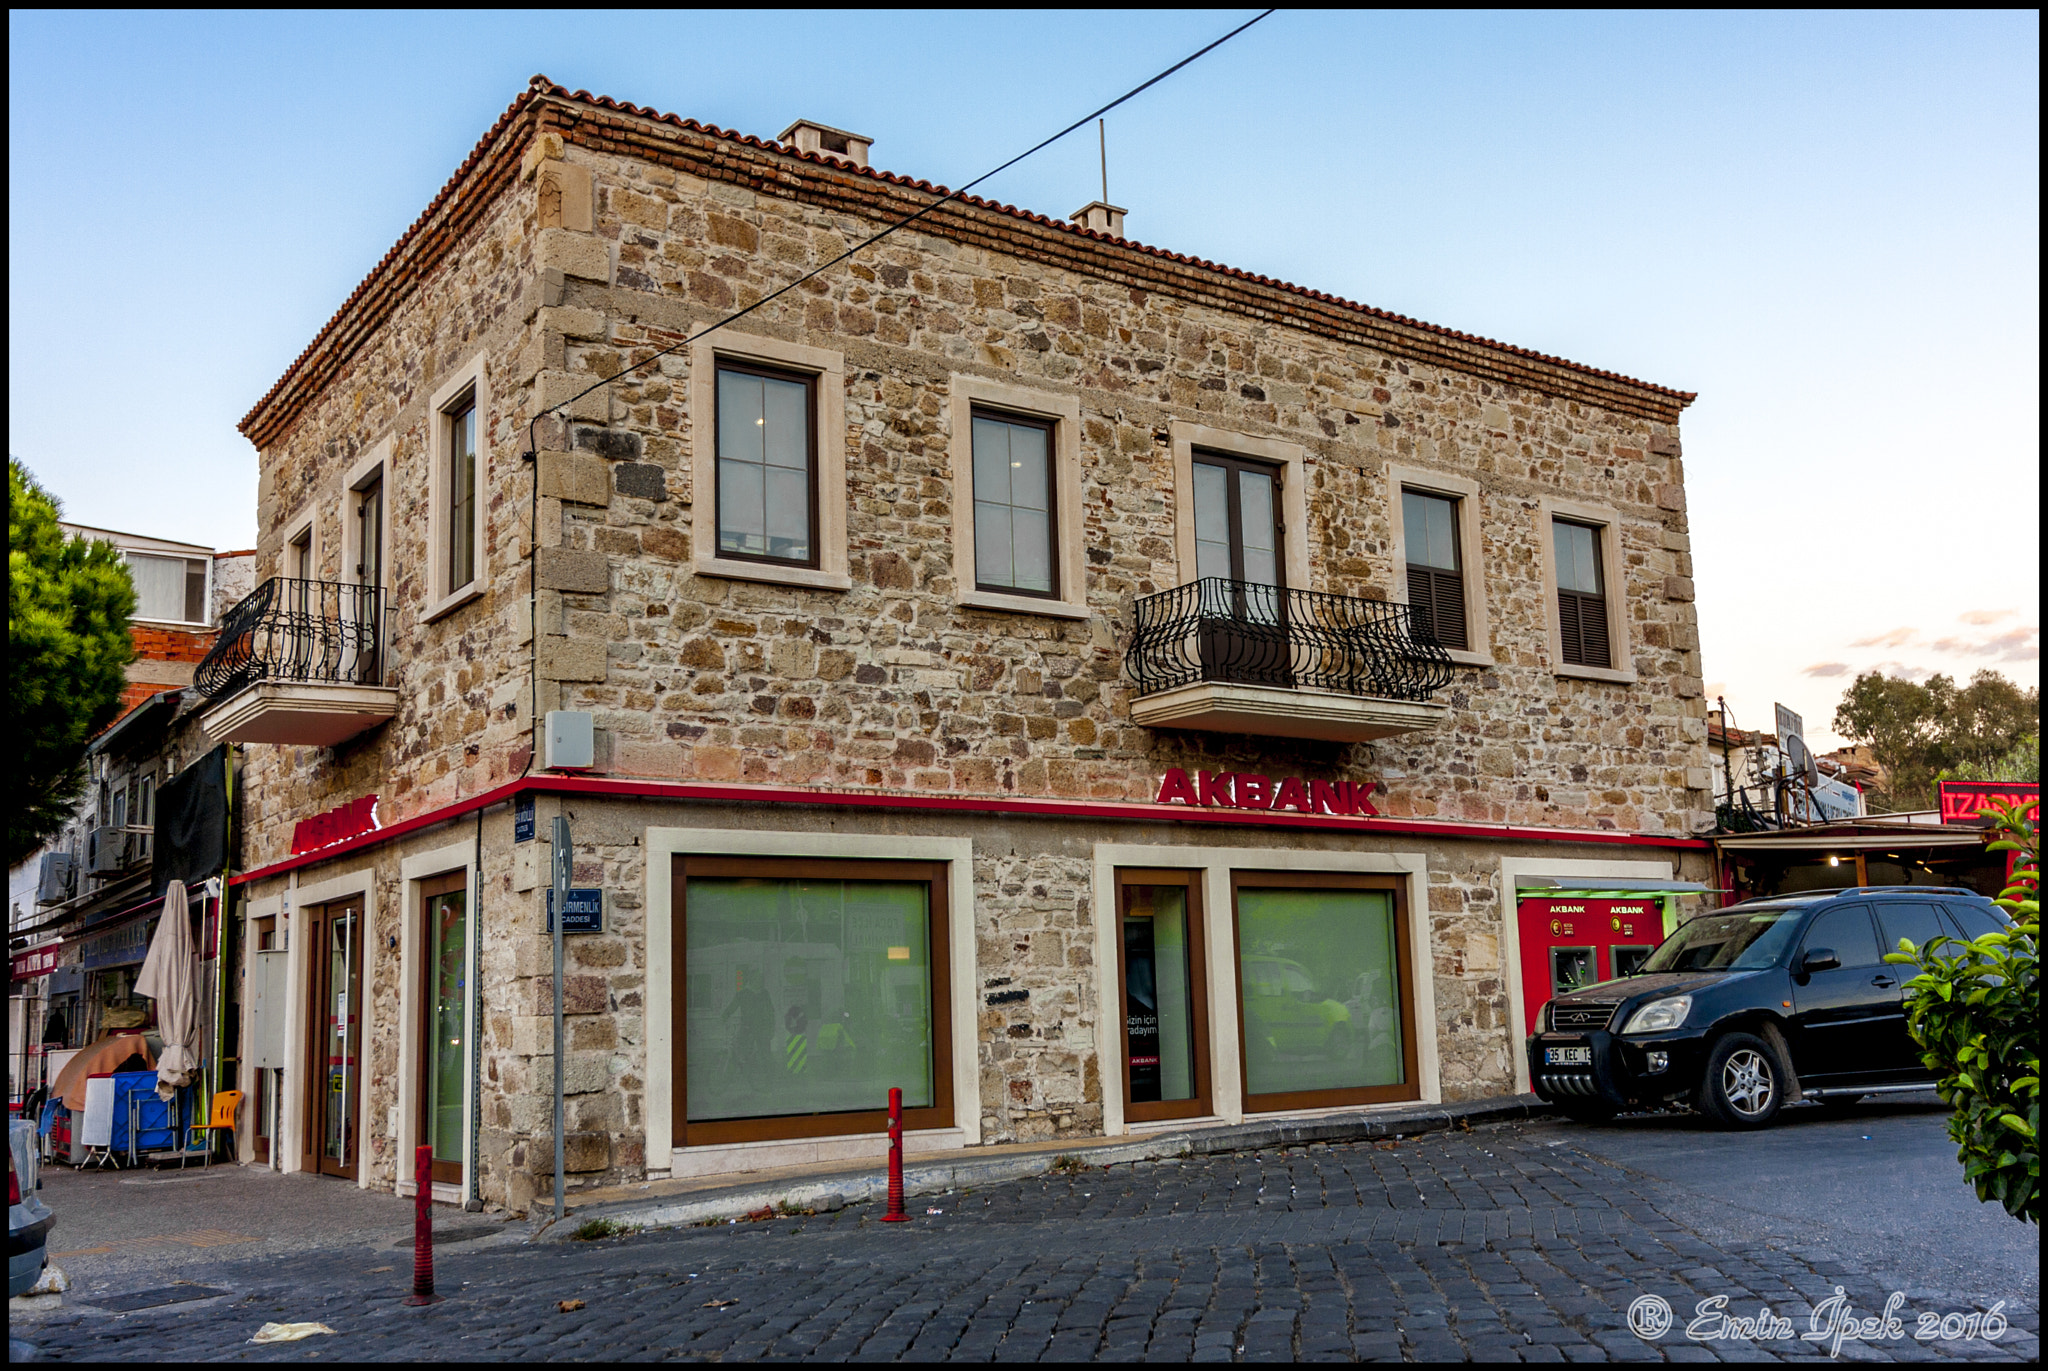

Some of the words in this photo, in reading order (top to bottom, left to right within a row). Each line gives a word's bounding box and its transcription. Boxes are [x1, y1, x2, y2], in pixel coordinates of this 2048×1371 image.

[1157, 767, 1379, 815] AKBANK
[1550, 905, 1585, 914] AKBANK
[1610, 906, 1644, 915] AKBANK
[1127, 1014, 1142, 1025] izin
[1143, 1014, 1157, 1026] için
[1550, 1048, 1559, 1061] 35
[1564, 1048, 1578, 1061] KEC
